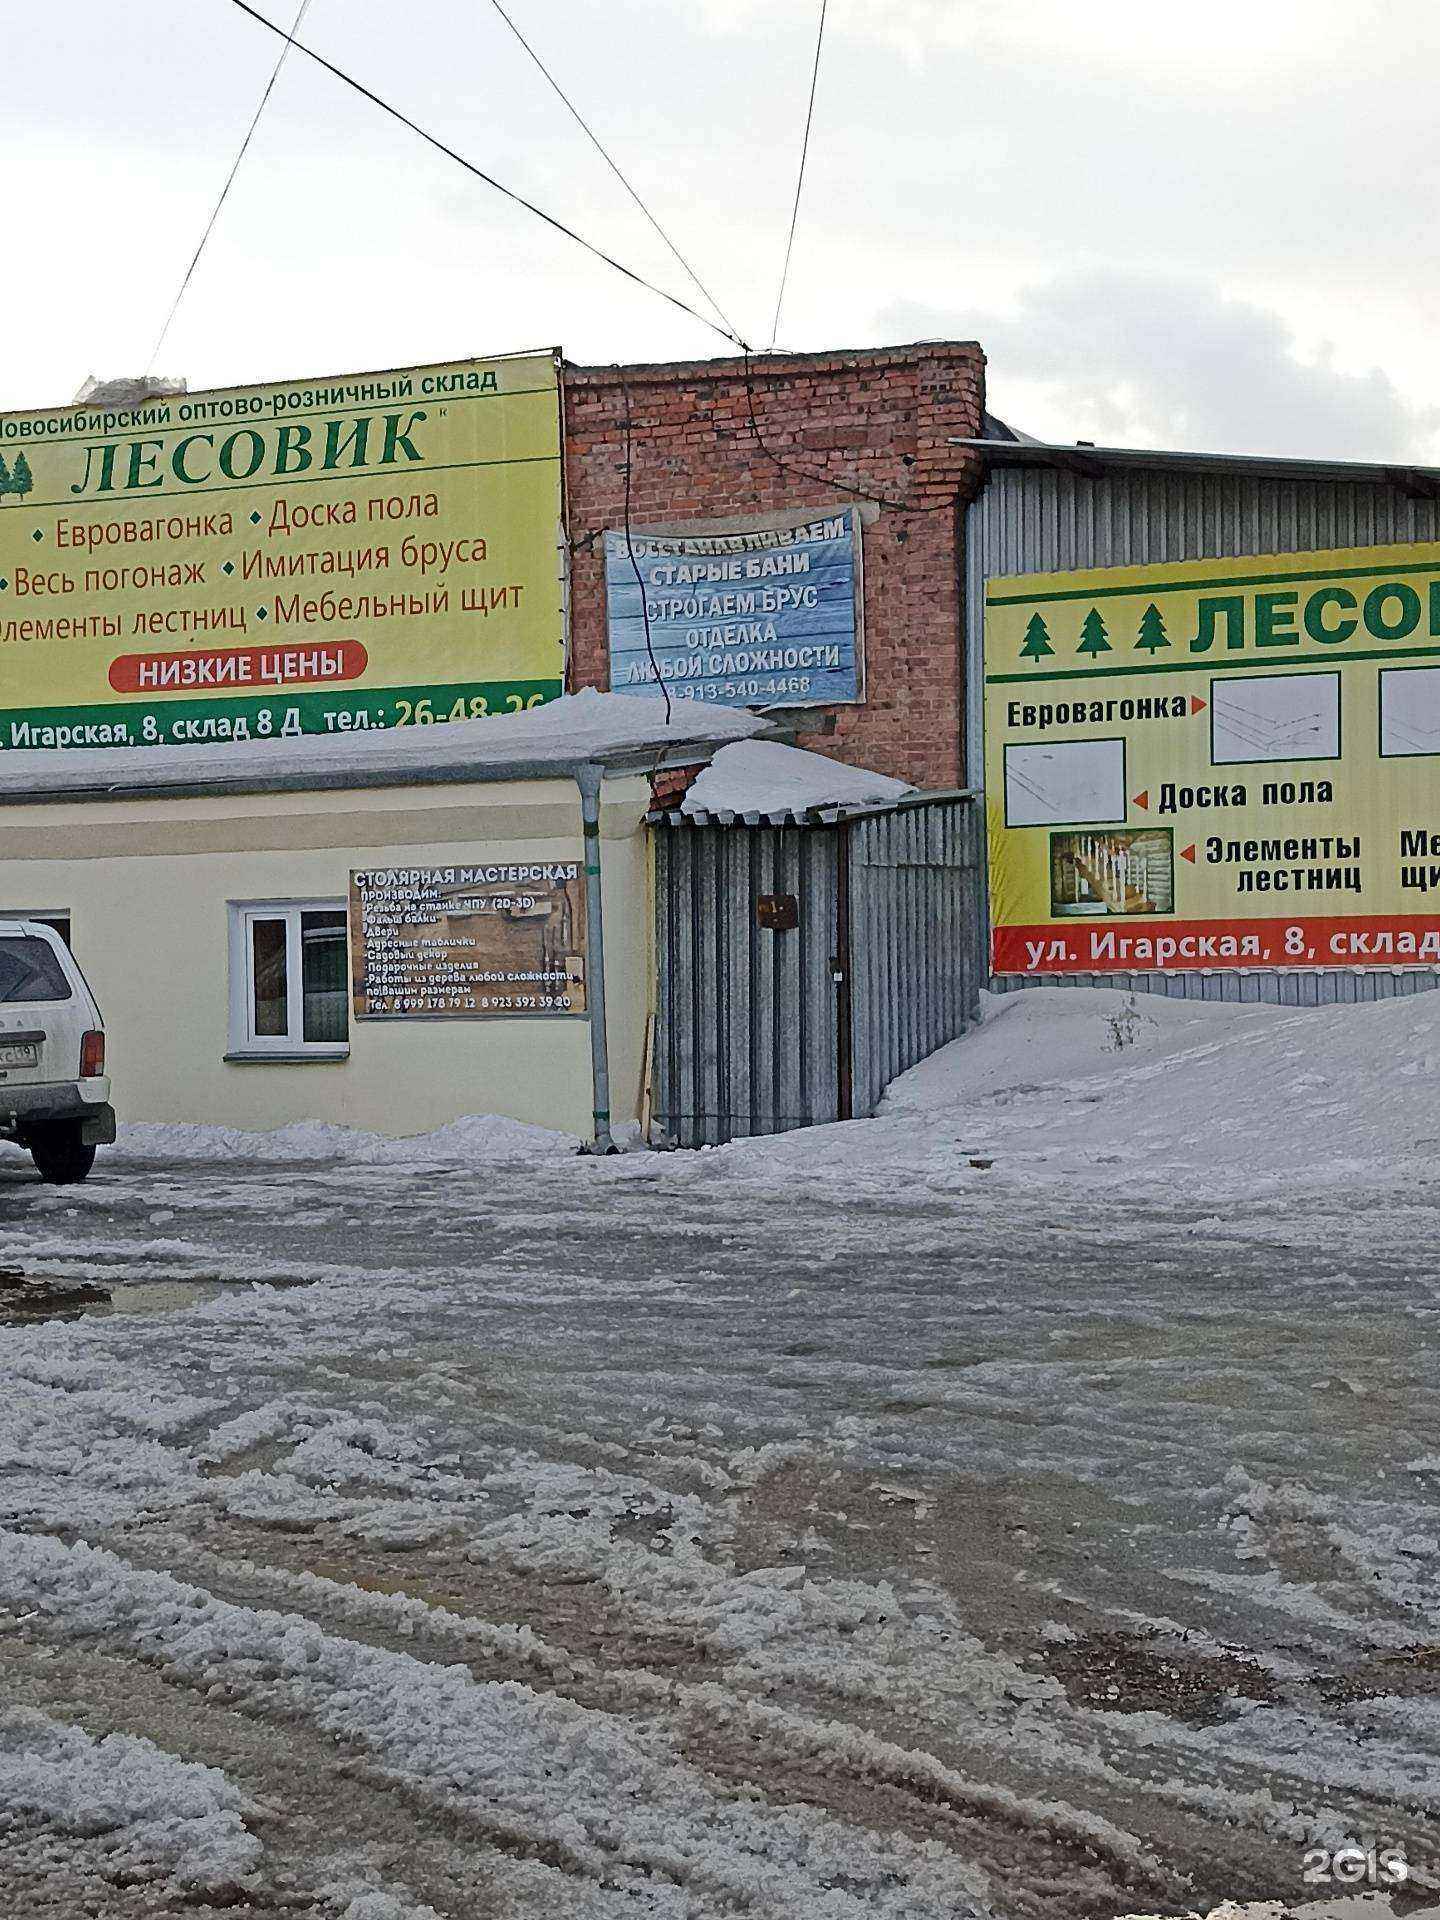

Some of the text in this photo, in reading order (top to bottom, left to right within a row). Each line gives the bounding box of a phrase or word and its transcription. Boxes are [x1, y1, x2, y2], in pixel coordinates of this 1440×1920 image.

[0, 370, 497, 438] овосибирский оптово-розничный склад
[70, 411, 427, 493] ЛЕСОВИК
[268, 493, 439, 537] Доска пола
[57, 512, 233, 554] Евровагонка
[242, 534, 487, 580] Имитация бруса
[651, 553, 810, 586] СТАРЫЕ БАНИ
[15, 562, 205, 596] Весь погонаж
[274, 582, 524, 624] Мебельный щит
[646, 586, 818, 622] СТРОГАЕМ БРУС
[1190, 581, 1440, 653] ЛЕСО
[0, 606, 247, 642] лементы лестниц
[686, 622, 778, 650] ОТДЕЛКА
[139, 650, 343, 686] НИЗКИЕ ЦЕНЫ
[627, 645, 839, 683] ЛЮБОЙ СЛОЖНОСТИ
[10, 721, 135, 749] Игарская,
[142, 715, 165, 743] 8,
[172, 717, 250, 741] склад
[257, 708, 272, 735] 8
[280, 707, 303, 738] Д
[323, 709, 385, 731] тел.:
[1007, 695, 1187, 730] Евровагонка
[1158, 779, 1333, 814] Доска пола
[1206, 836, 1361, 864] Элементы
[355, 864, 578, 887] СТОЛЯРНАЯ МАСТЕРСКАЯ
[1237, 867, 1362, 893] лестниц
[361, 889, 441, 902] ПРОИЗВОДИМ:
[464, 899, 486, 910] ЧПУ
[366, 927, 399, 939] Двери
[1025, 926, 1440, 969] ул. Игарская, 8, склад
[417, 949, 447, 961] декор
[435, 961, 479, 973] изделия
[429, 971, 466, 985] дерева
[469, 971, 504, 982] любой
[507, 971, 573, 981] сложности
